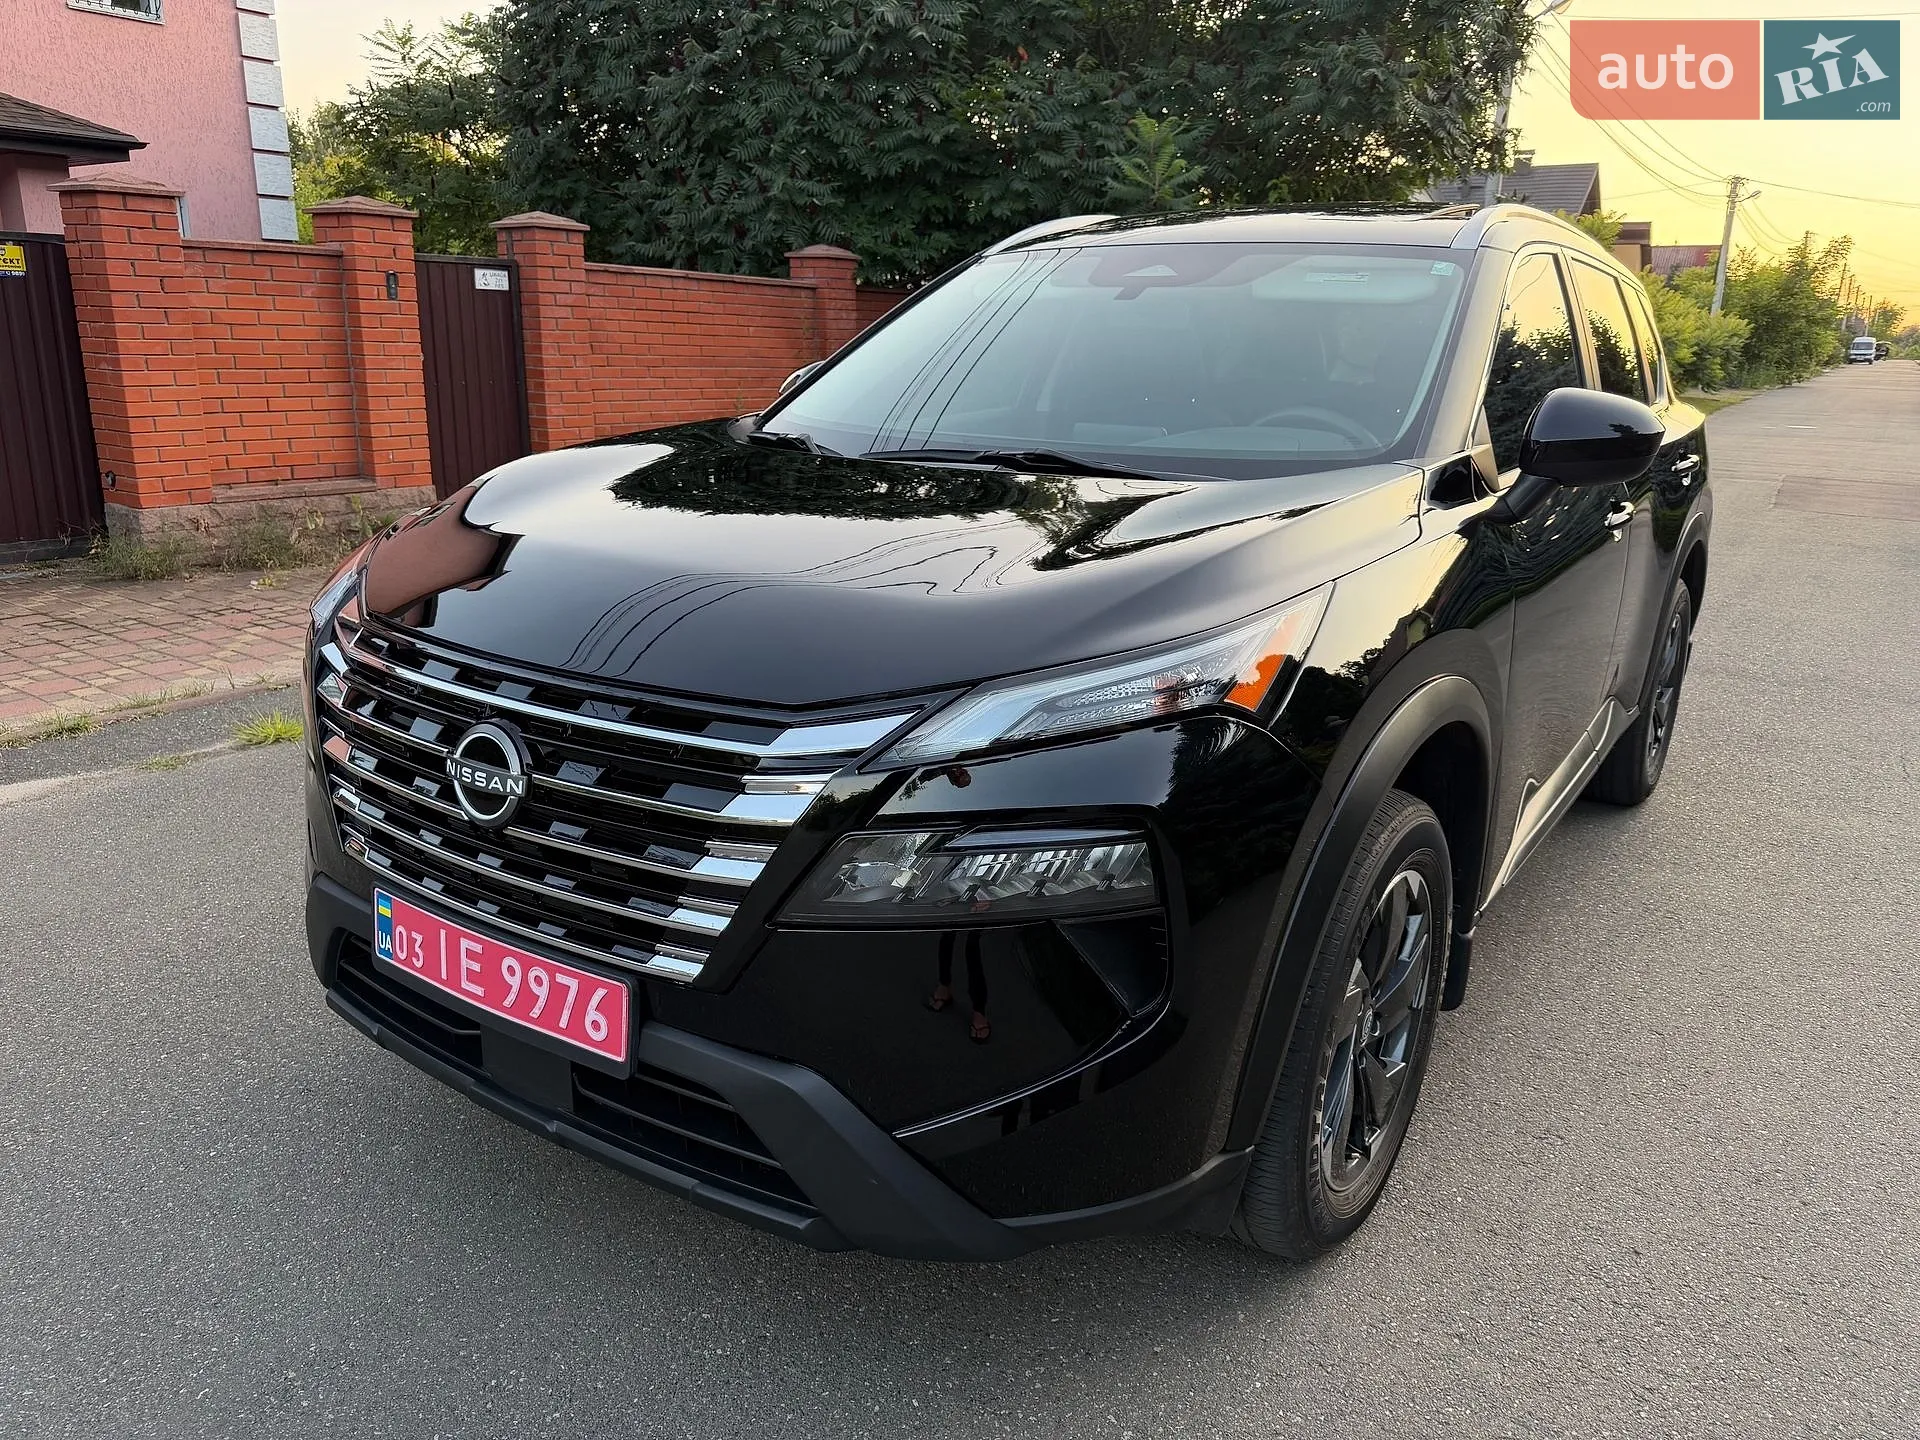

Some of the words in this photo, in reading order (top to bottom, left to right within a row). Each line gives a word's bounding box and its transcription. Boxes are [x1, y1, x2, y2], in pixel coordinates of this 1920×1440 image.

[446, 758, 523, 795] NISSAN
[378, 931, 393, 953] UA
[395, 924, 424, 969] 03
[439, 928, 485, 998] IE
[501, 956, 609, 1042] 9976
